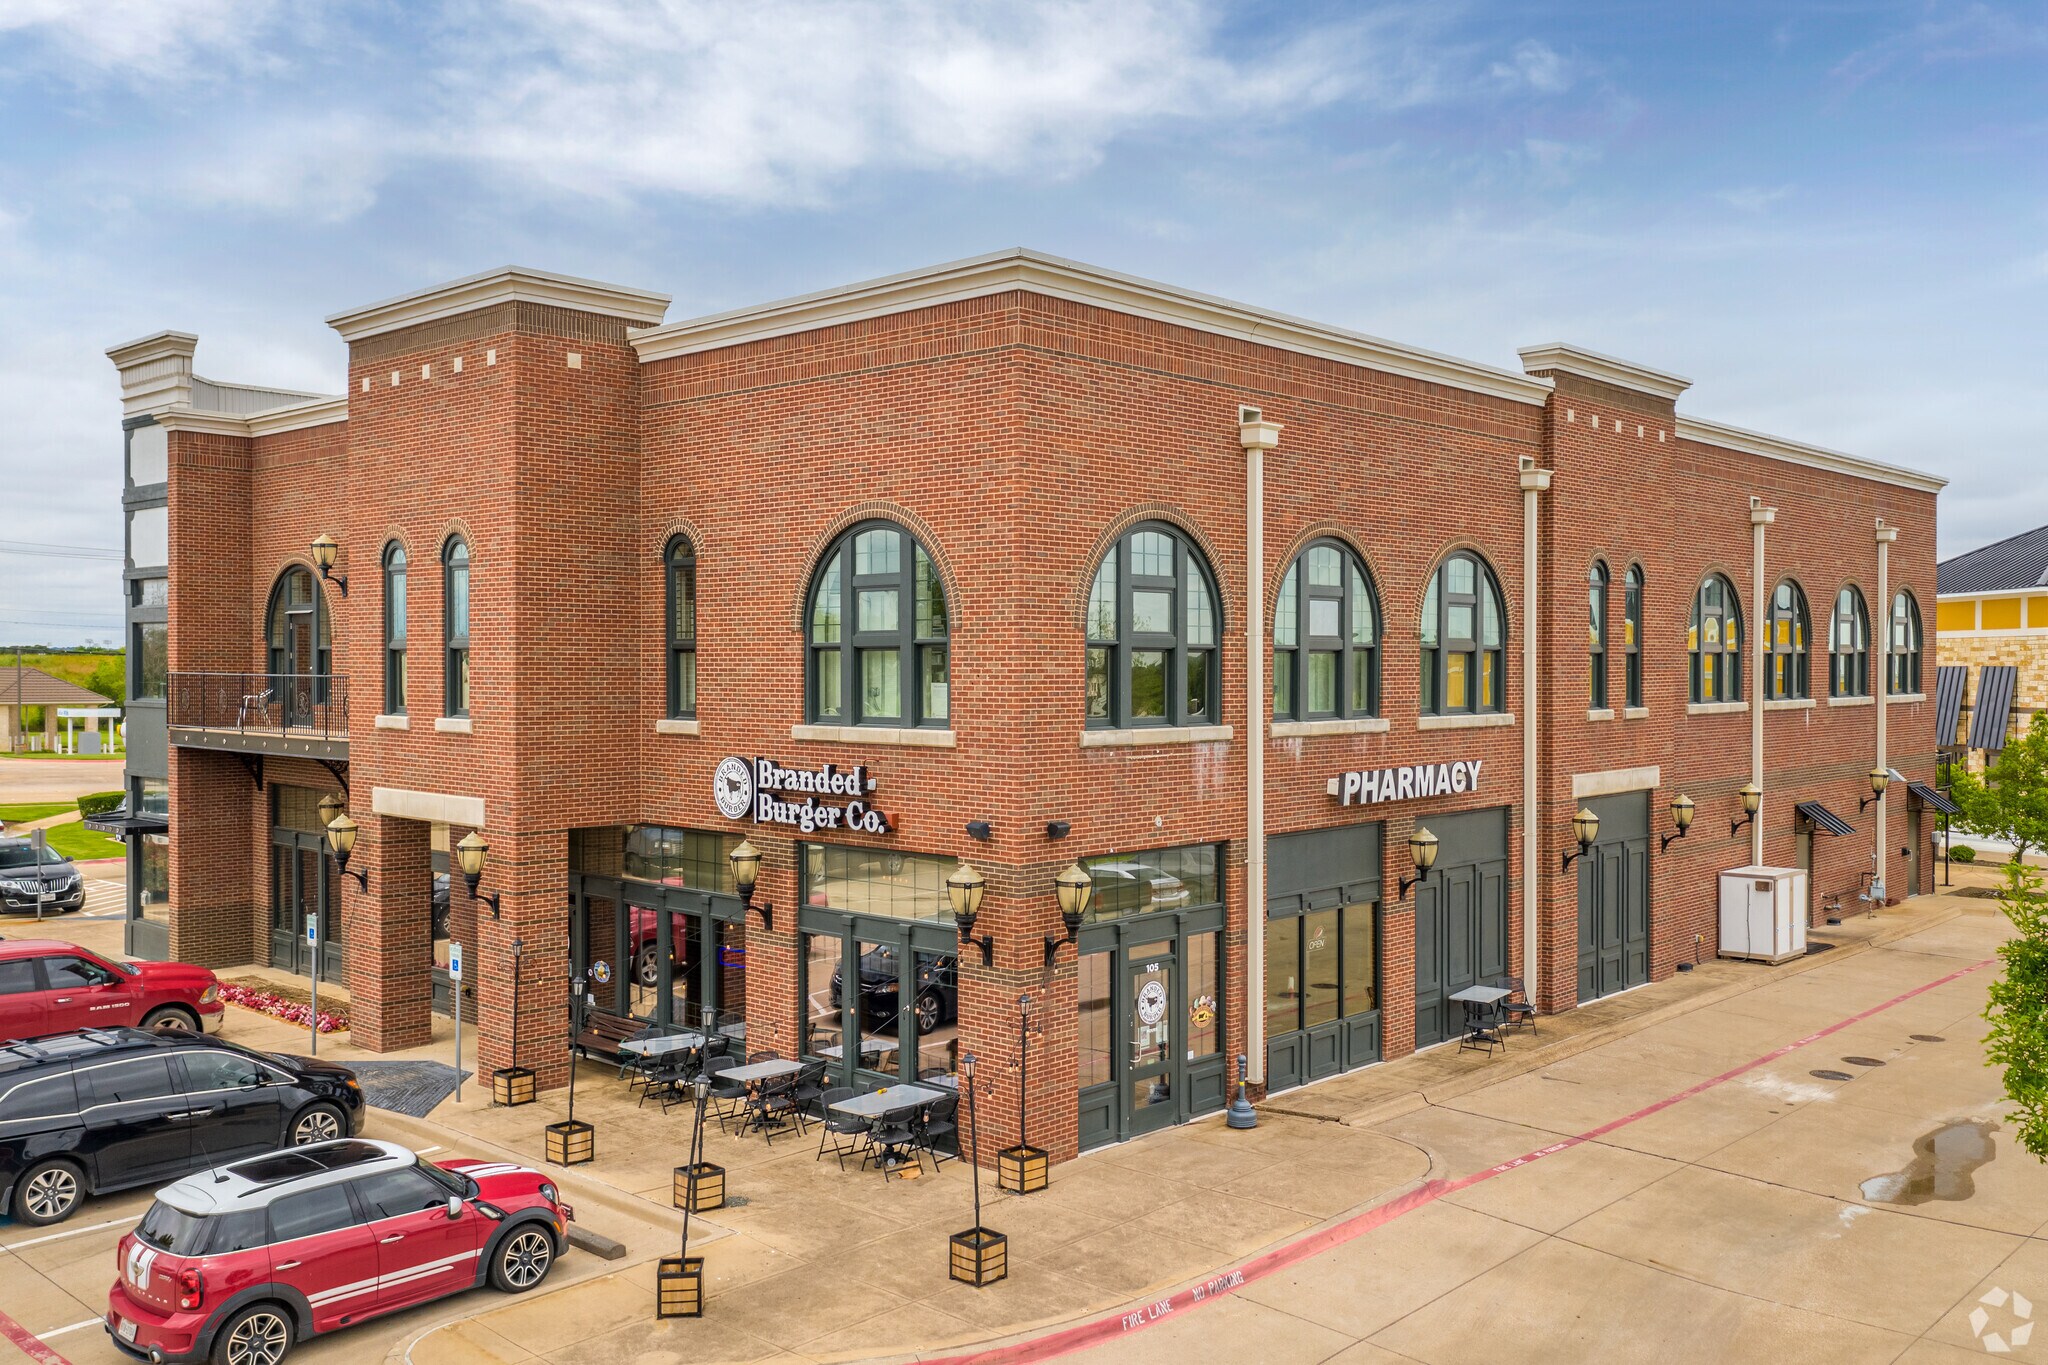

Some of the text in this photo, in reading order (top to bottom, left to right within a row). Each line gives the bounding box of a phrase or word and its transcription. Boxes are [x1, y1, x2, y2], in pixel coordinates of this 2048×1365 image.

[718, 763, 748, 785] BRANDED
[758, 759, 862, 796] Branded
[1343, 760, 1482, 806] PHARMACY
[720, 796, 746, 813] BURGER
[758, 793, 885, 834] Burger Co.
[1146, 962, 1159, 973] 105
[1122, 1270, 1245, 1331] FIRE LANE NO PARKING
